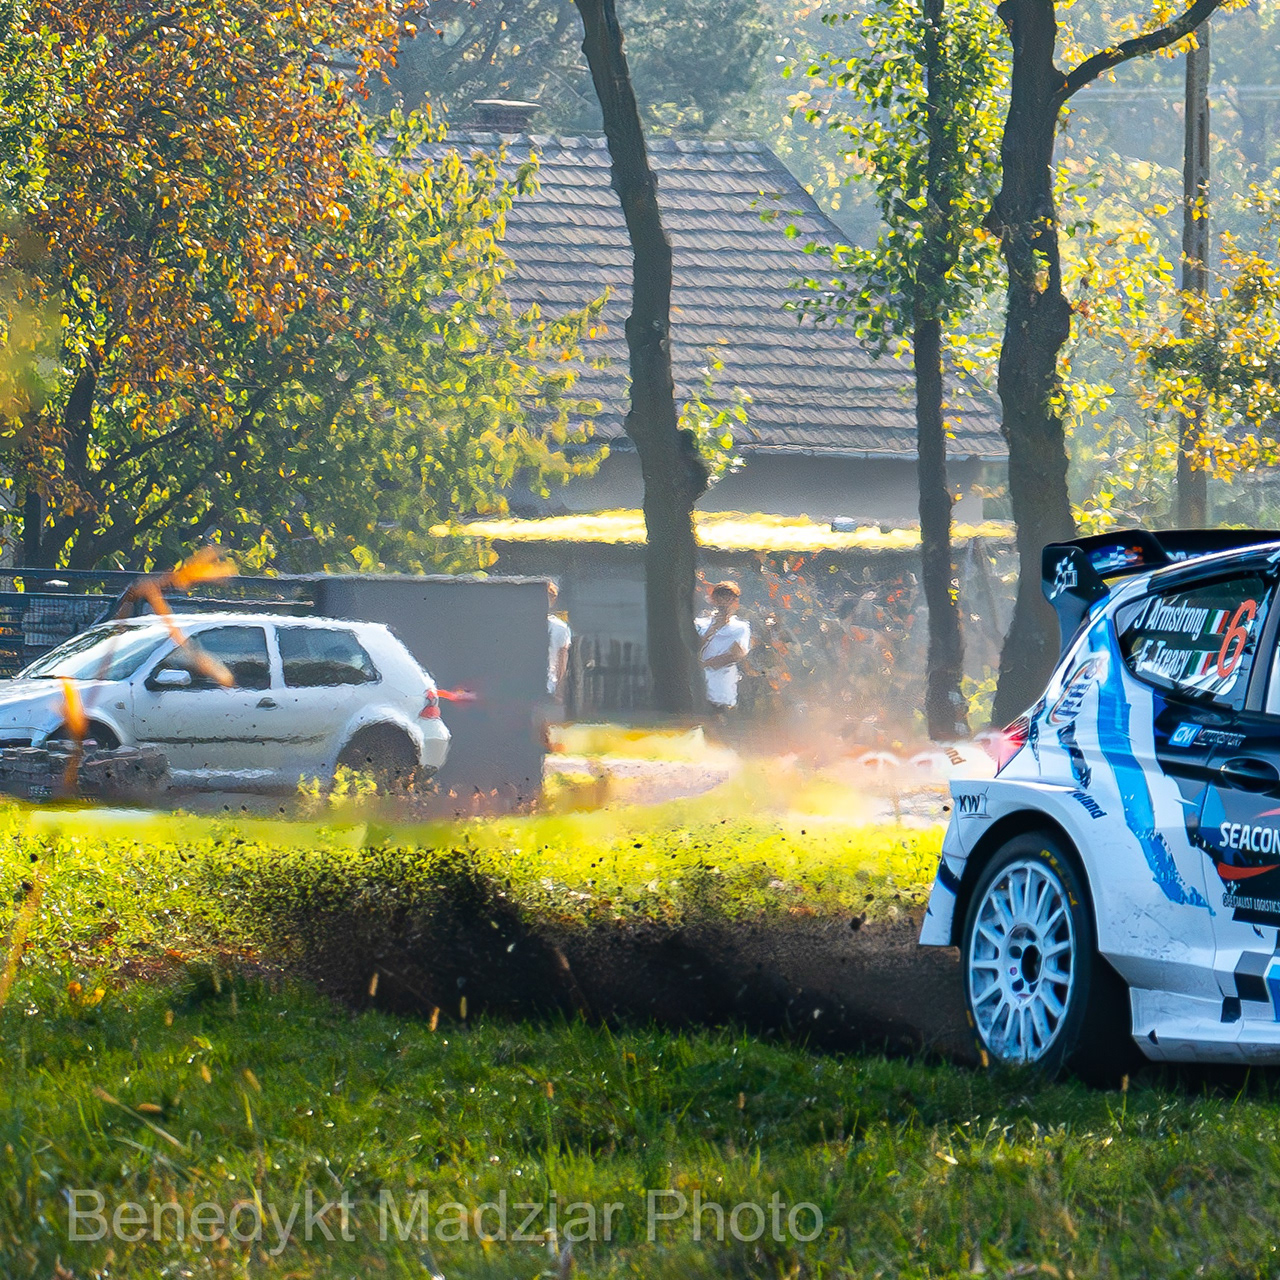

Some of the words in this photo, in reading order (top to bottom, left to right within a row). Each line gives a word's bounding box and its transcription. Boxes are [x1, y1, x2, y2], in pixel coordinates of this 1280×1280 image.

[1134, 595, 1156, 629] J
[1145, 597, 1209, 641] Armstrong
[1217, 599, 1257, 678] 6
[1152, 640, 1195, 682] Treacy
[959, 795, 980, 813] KW
